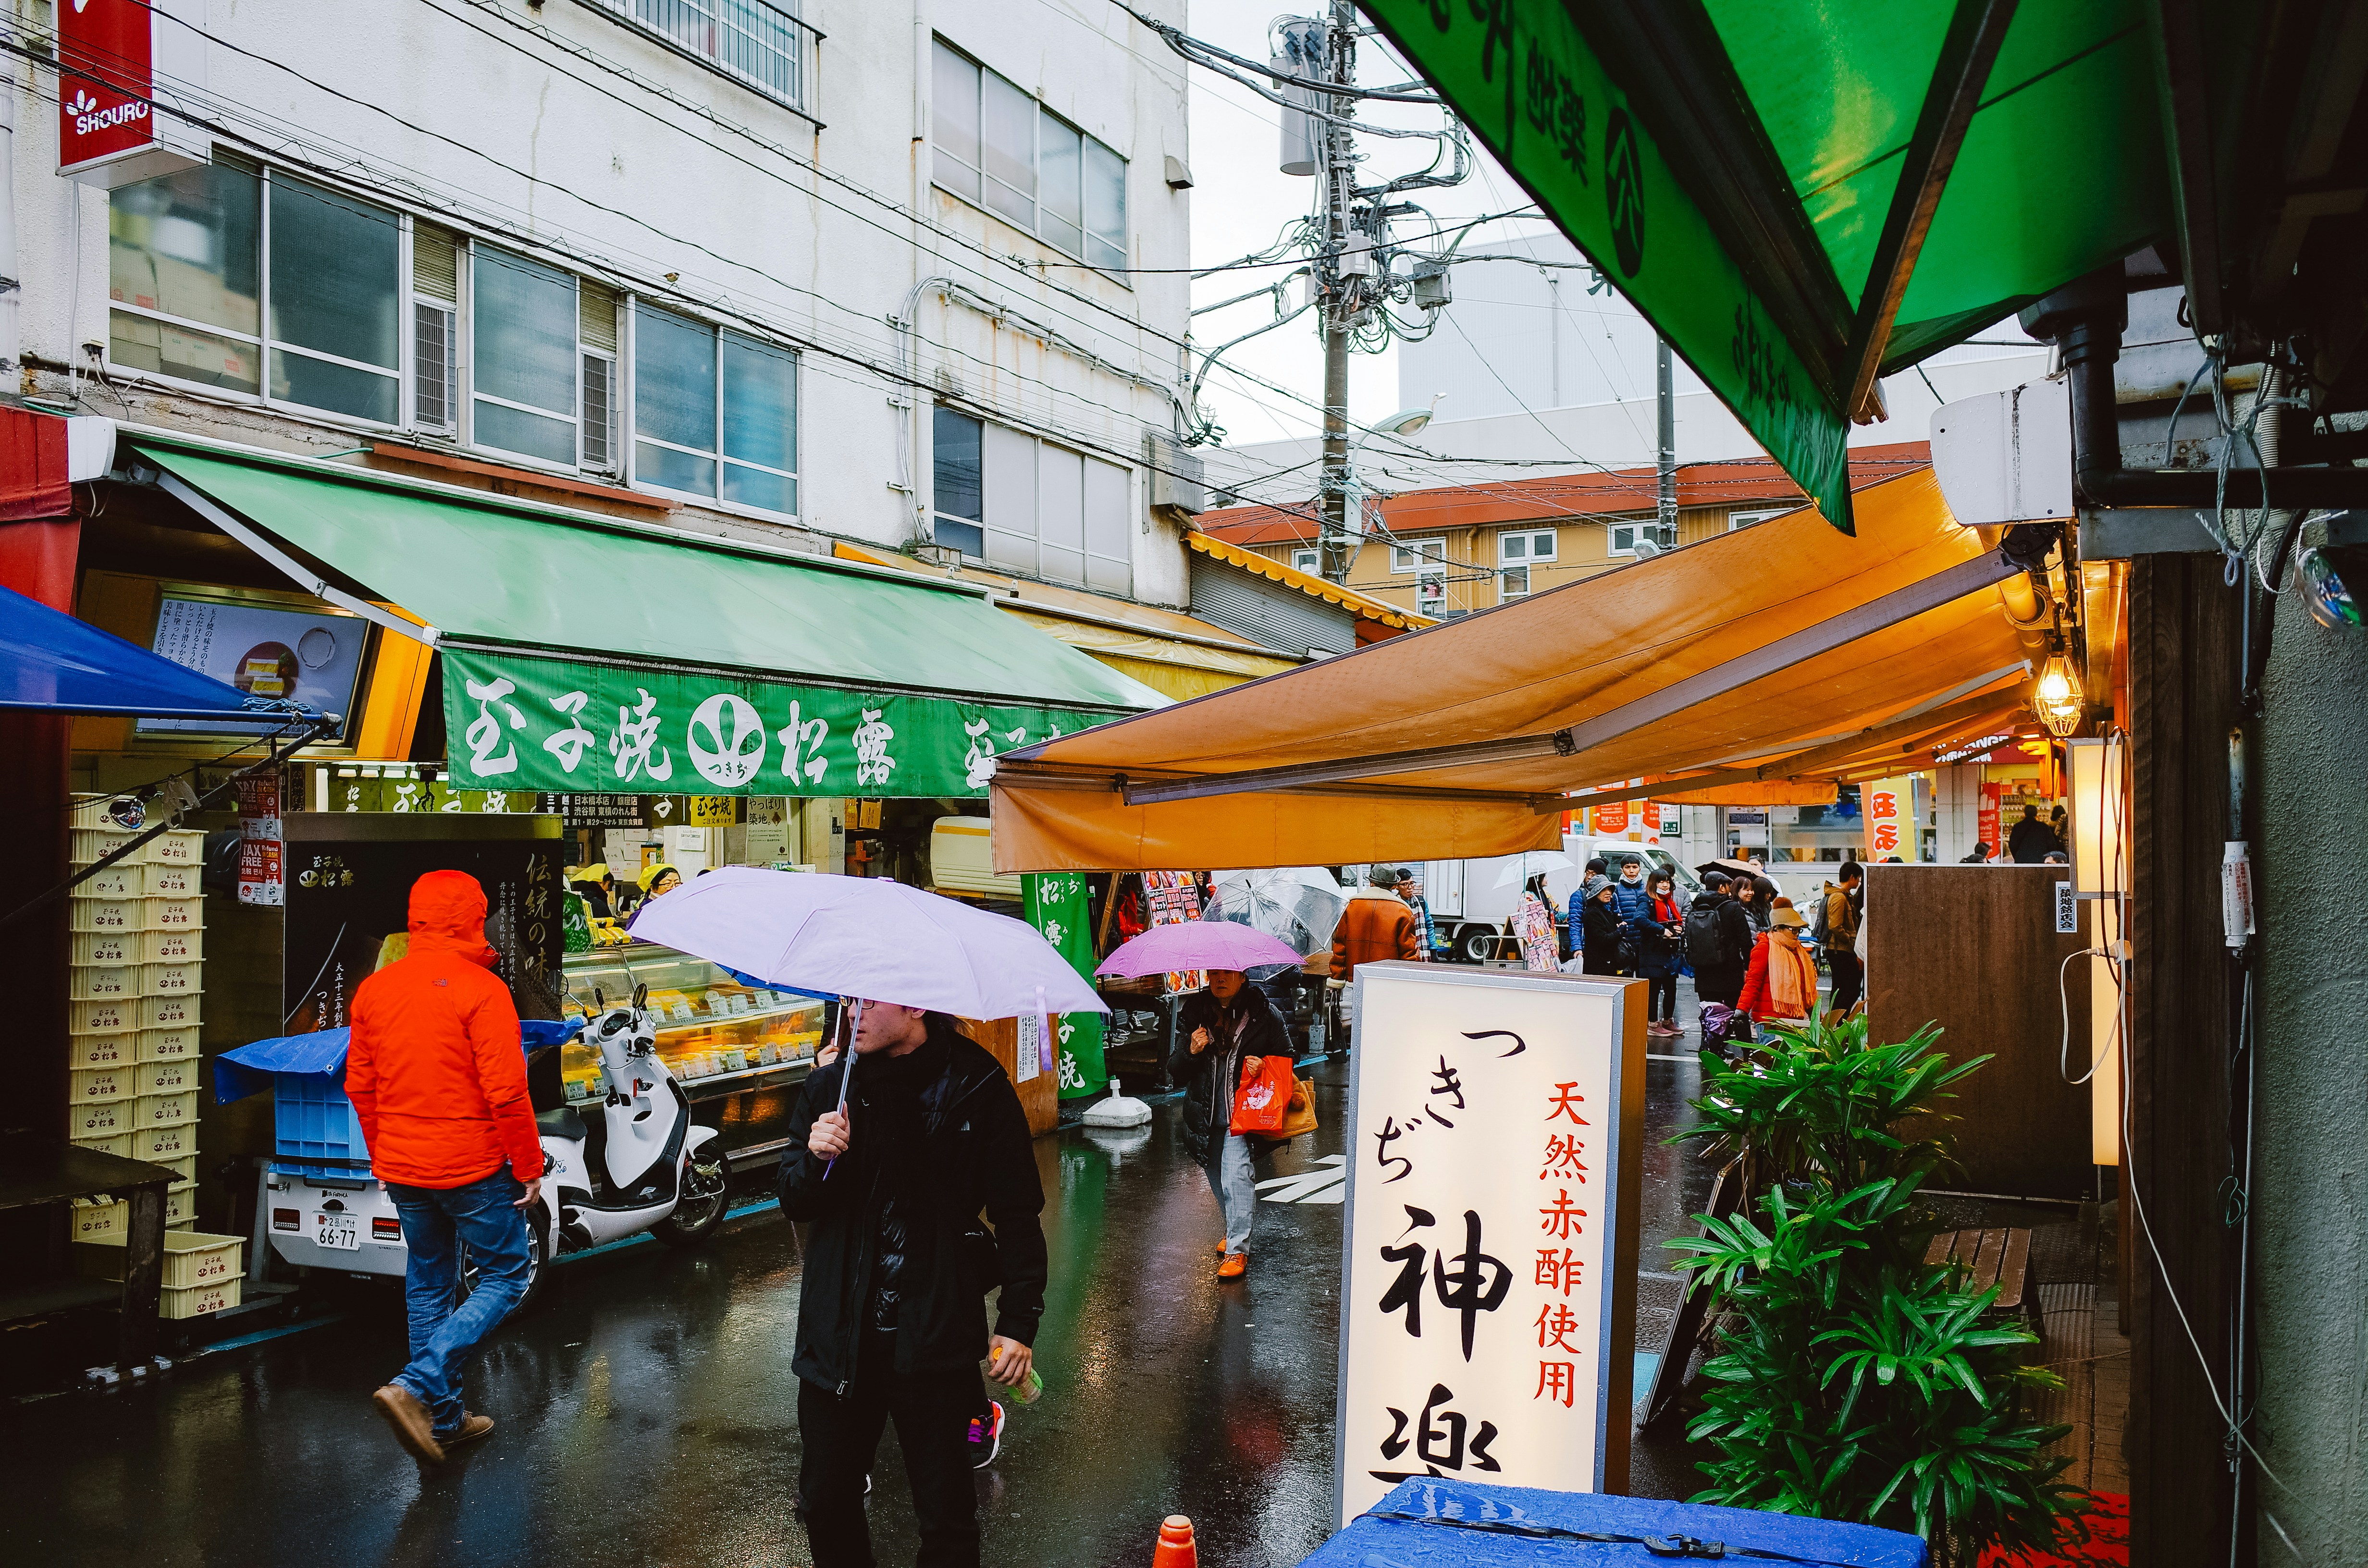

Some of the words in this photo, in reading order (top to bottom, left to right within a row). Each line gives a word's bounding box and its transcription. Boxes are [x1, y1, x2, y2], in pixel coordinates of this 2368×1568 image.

[76, 100, 148, 135] SHOURO
[465, 676, 673, 783] 玉子焼
[777, 698, 897, 787] 松露
[708, 760, 747, 779] つきぢ
[574, 796, 609, 806] 日本橋本店
[574, 806, 596, 816] 渋谷駅
[697, 796, 732, 817] 玉子焼
[243, 844, 261, 857] TAX
[242, 857, 262, 867] FREE
[525, 853, 551, 980] 伝統の味
[1373, 1029, 1527, 1185] つきぢ
[319, 1227, 356, 1247] 66-77
[1533, 1081, 1591, 1409] 天然赤酢使用
